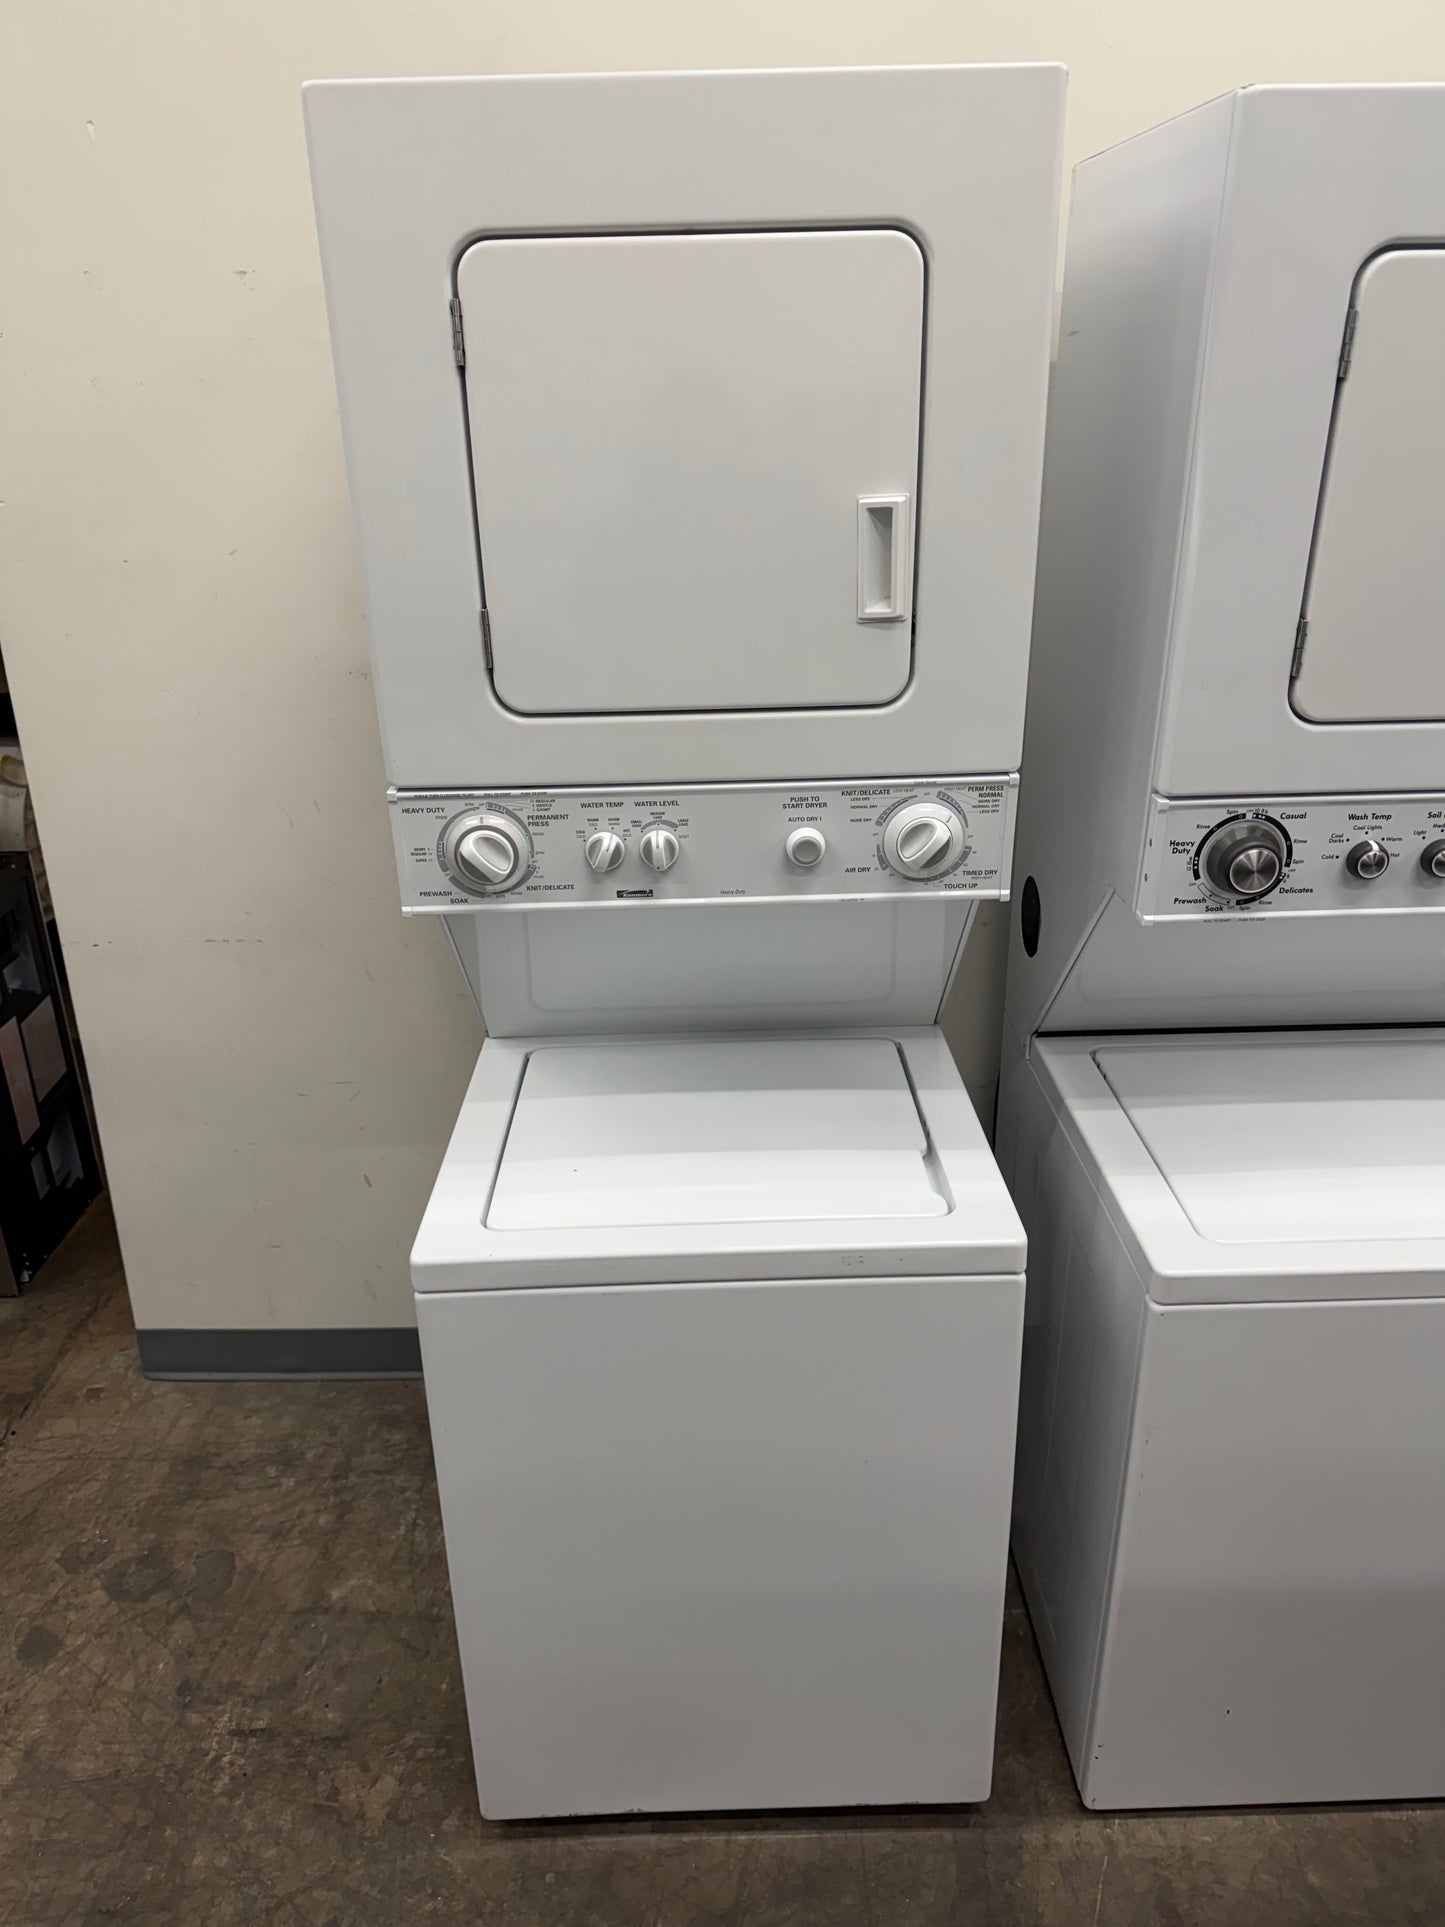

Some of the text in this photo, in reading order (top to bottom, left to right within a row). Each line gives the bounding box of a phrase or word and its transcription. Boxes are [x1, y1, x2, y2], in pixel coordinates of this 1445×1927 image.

[1280, 812, 1307, 820] Casual
[1348, 812, 1393, 821] Wash Temp
[1427, 811, 1442, 819] Soil
[1169, 839, 1196, 848] Heavy
[1172, 847, 1191, 855] Duty
[1173, 896, 1207, 905] Prewash
[1205, 904, 1224, 912] Soak
